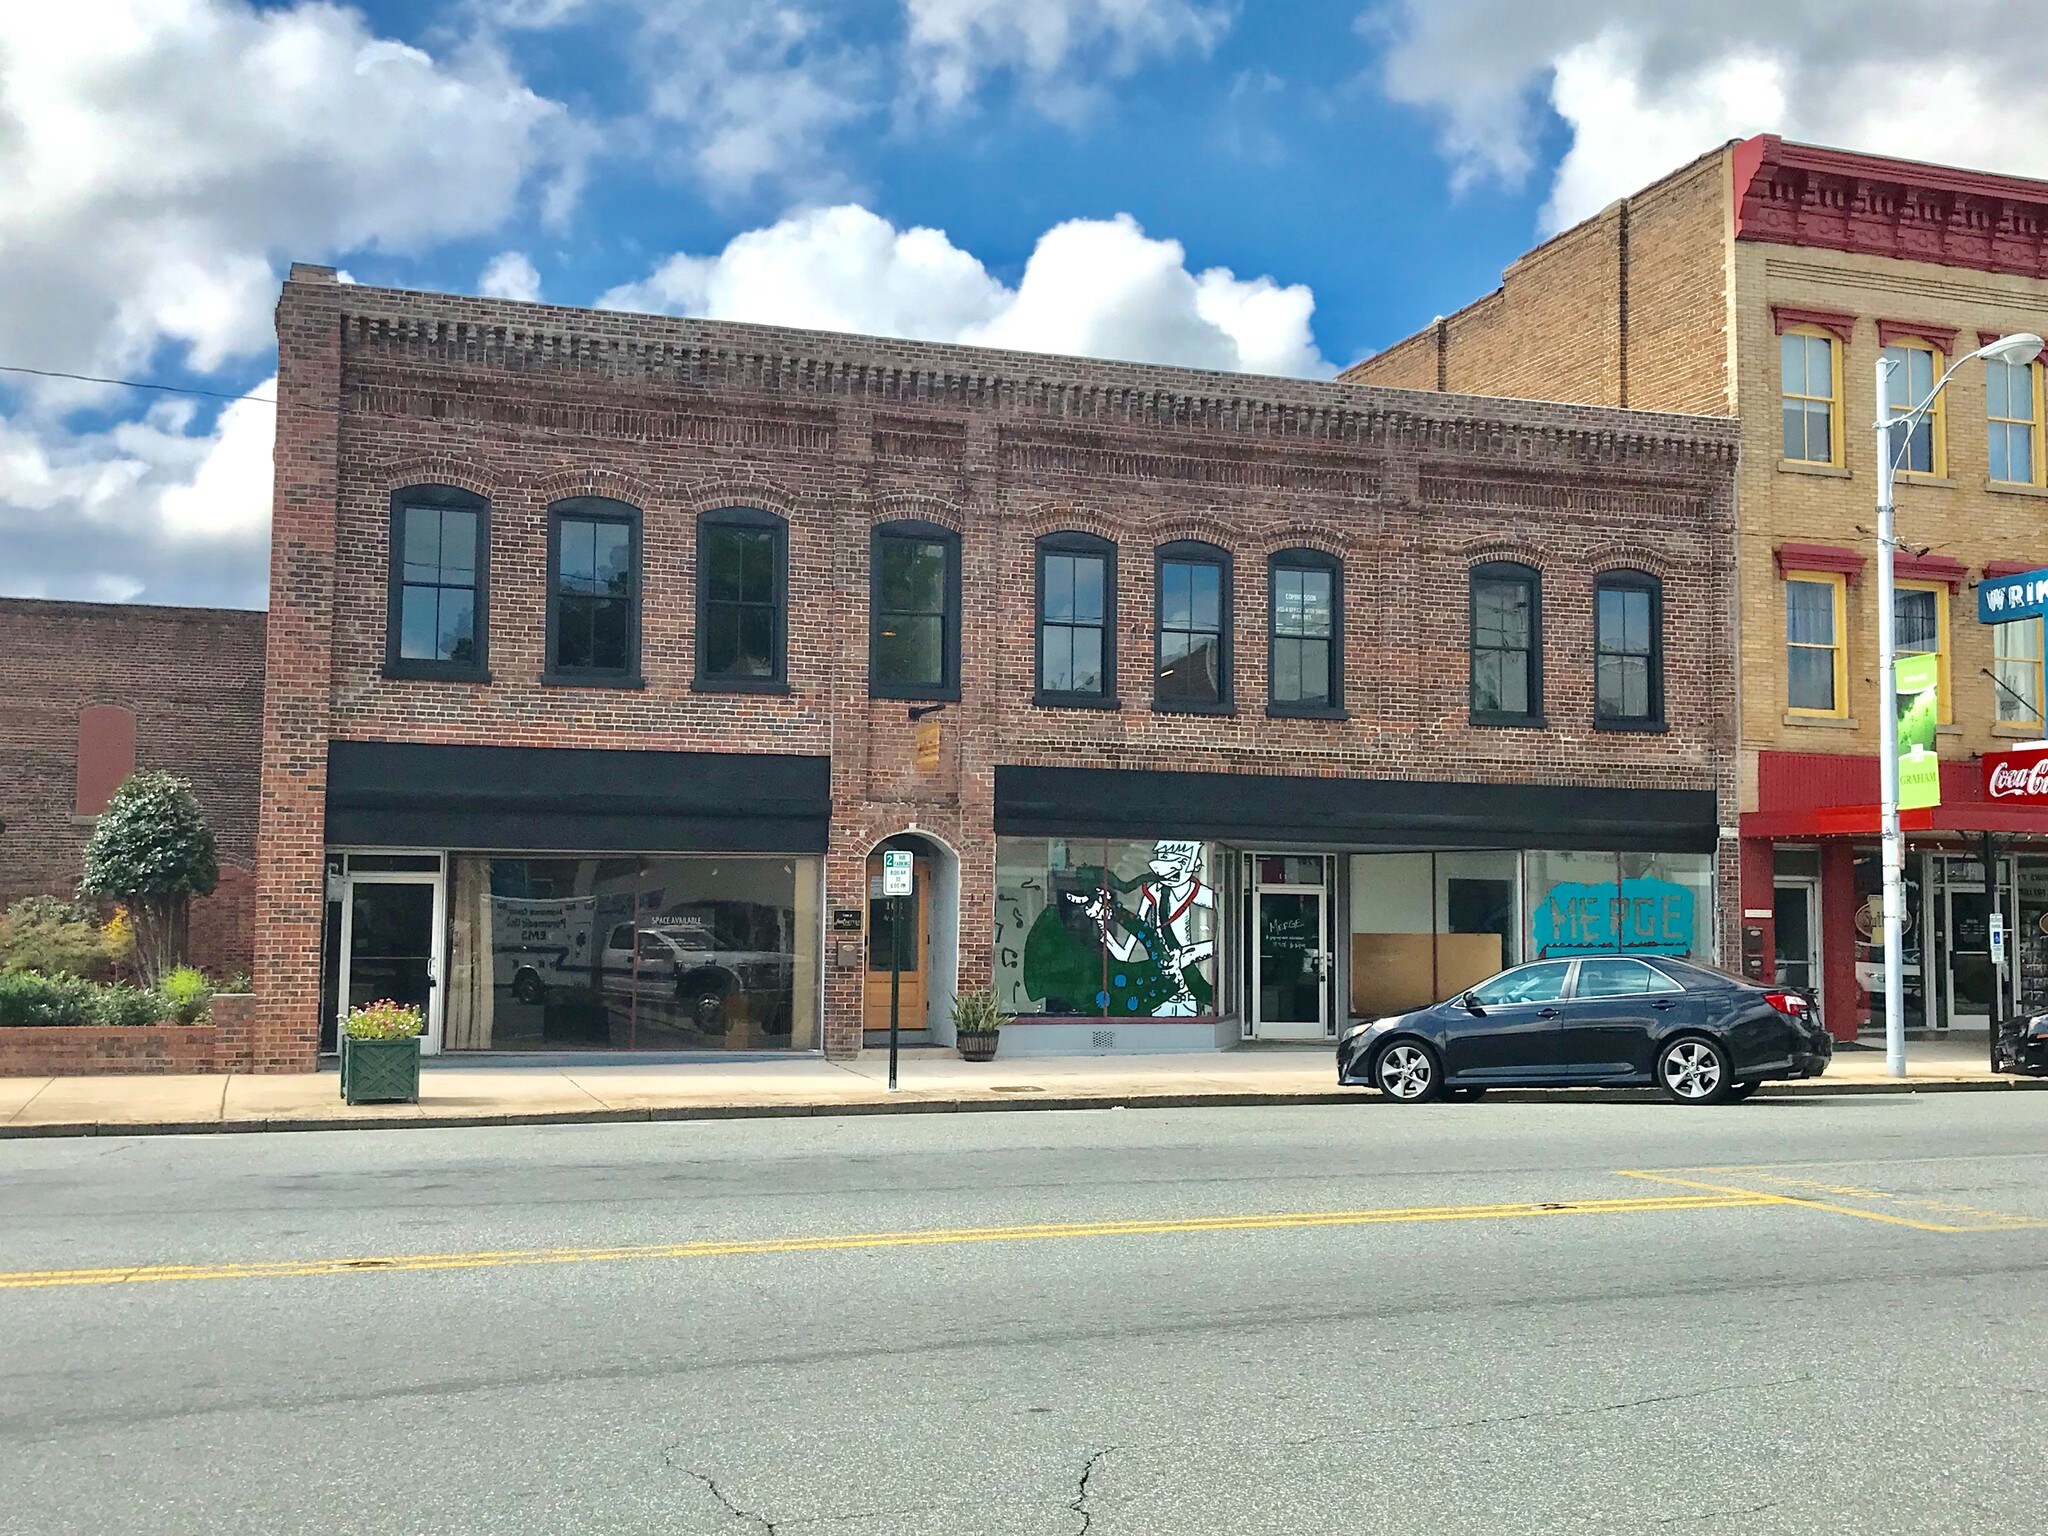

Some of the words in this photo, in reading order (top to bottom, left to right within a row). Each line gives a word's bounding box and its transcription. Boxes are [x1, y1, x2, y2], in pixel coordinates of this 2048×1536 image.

[1899, 772, 1936, 785] GRAHAM
[886, 855, 893, 866] 2
[651, 916, 670, 924] SPACE
[671, 915, 702, 924] AVAILABLE
[1550, 895, 1684, 942] MERGE
[1269, 919, 1304, 935] MERGE
